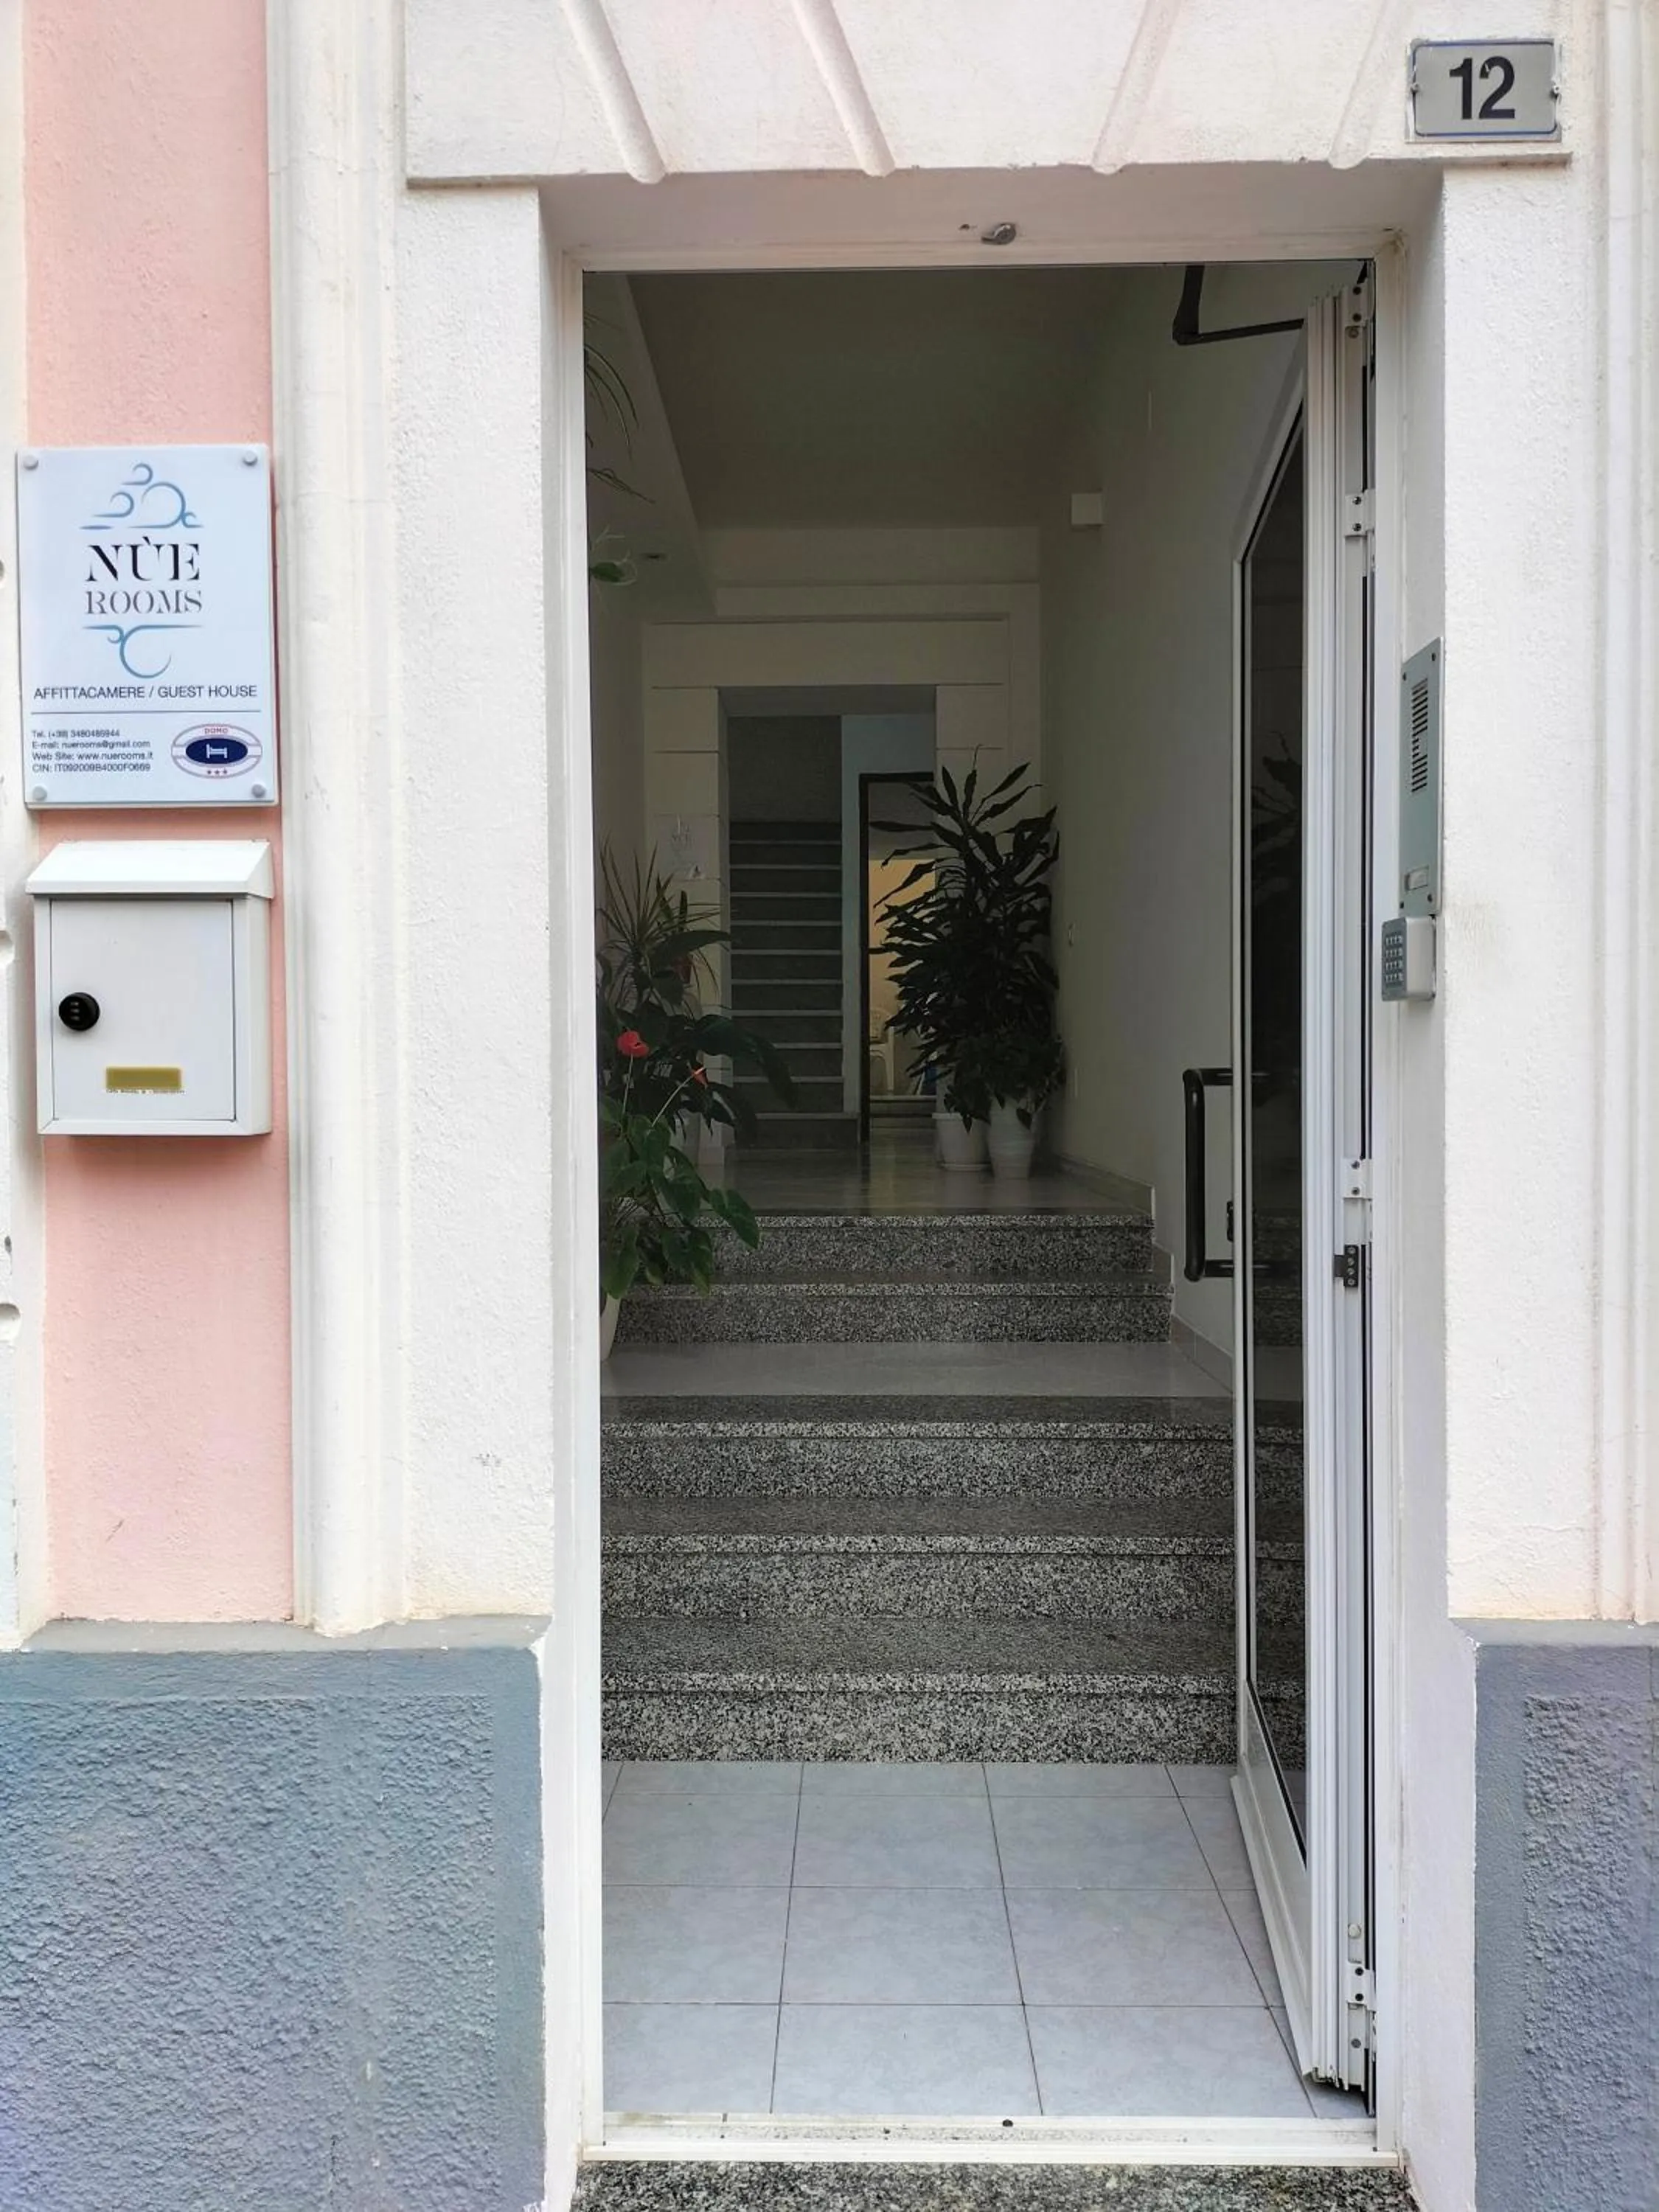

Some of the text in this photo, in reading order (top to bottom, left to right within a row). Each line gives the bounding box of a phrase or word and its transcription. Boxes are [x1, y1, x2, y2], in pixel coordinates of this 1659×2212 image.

[1449, 55, 1516, 119] 12
[85, 590, 203, 614] ROOMS
[34, 685, 257, 699] AFFITTACAMERE / GUEST HOUSE
[32, 740, 150, 750] E-mail: nuerooms@gmail.com
[32, 751, 153, 760] Web Site: www.nuerooms.it
[32, 764, 52, 773] CIN:
